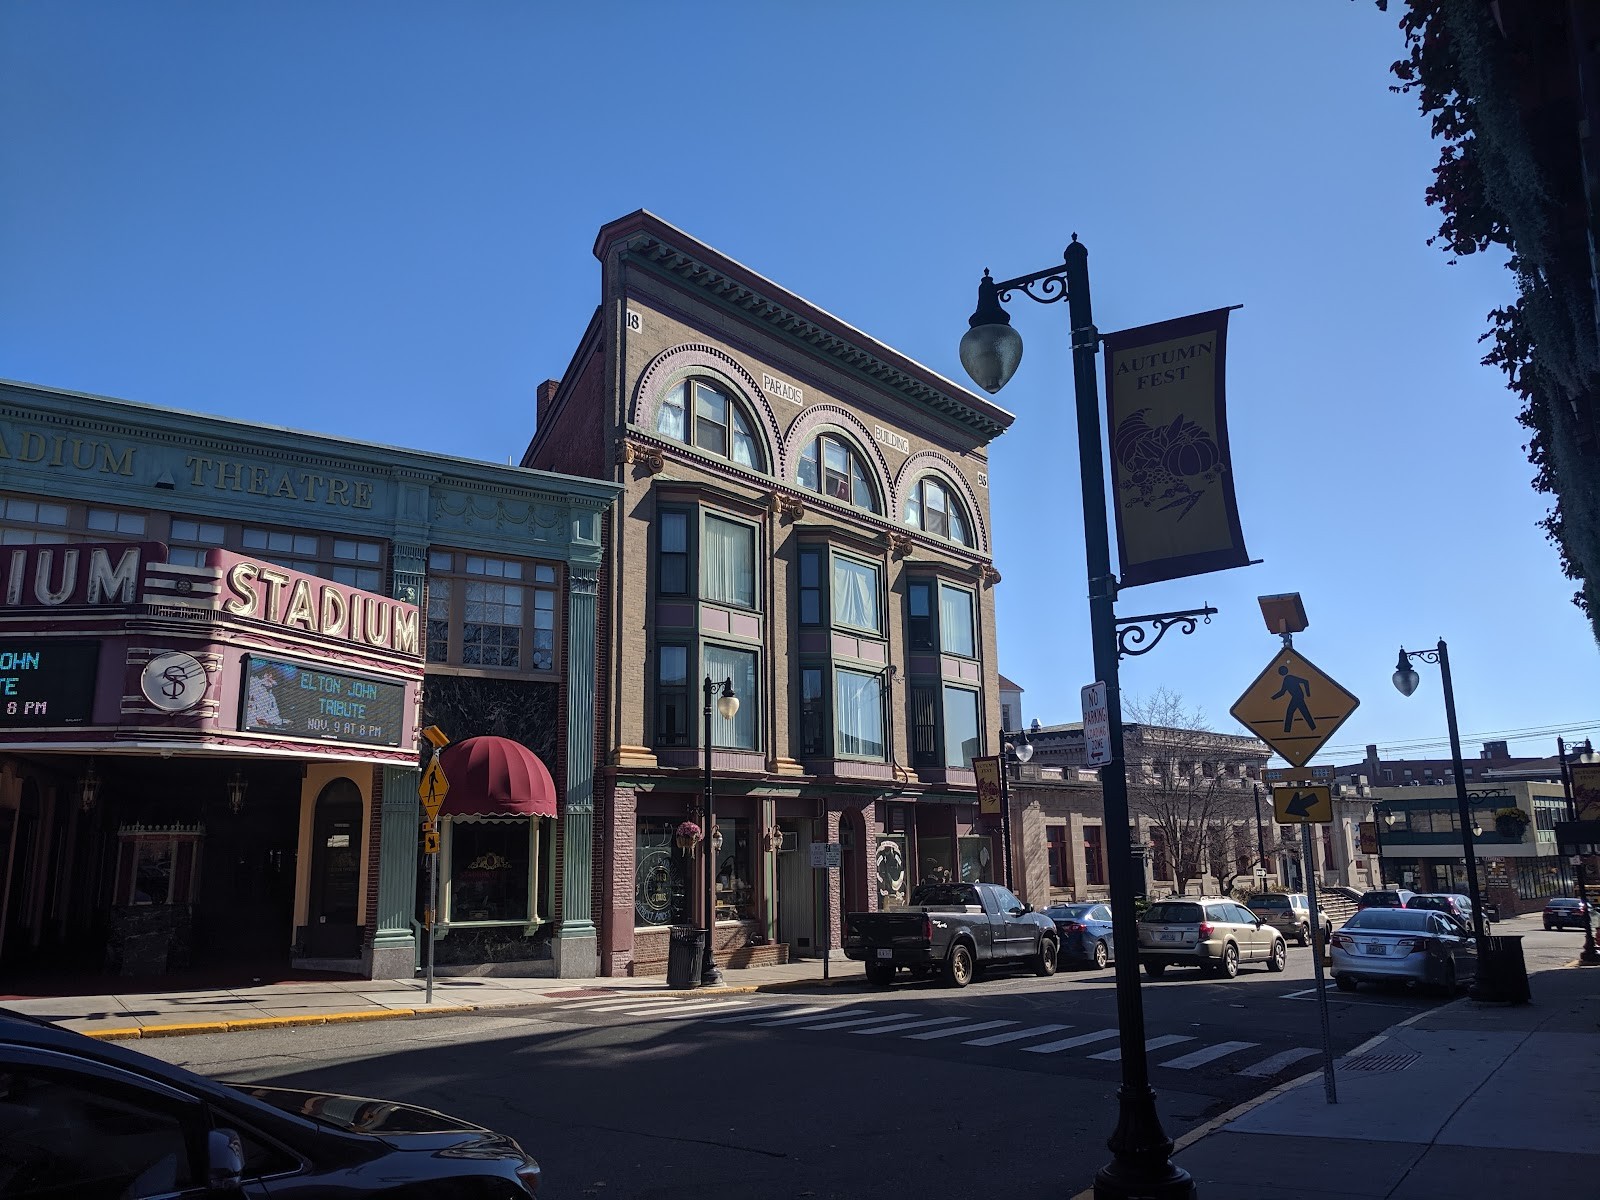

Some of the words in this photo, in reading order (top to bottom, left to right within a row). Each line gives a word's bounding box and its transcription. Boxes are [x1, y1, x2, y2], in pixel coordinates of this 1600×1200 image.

[626, 312, 640, 330] 18
[1116, 341, 1212, 376] AUTUMN
[763, 376, 803, 404] PARADIS
[1136, 365, 1190, 391] FEST
[874, 428, 909, 454] BUILDING
[186, 455, 374, 509] THEATRE
[221, 561, 419, 654] STADIUM
[300, 674, 341, 692] ELTON
[347, 681, 377, 699] JOHN
[1088, 690, 1099, 708] NO
[6, 701, 19, 716] 8
[24, 701, 48, 716] PM
[318, 699, 366, 718] TRIBUTE
[307, 717, 331, 732] NOV.
[335, 721, 341, 733] 9
[343, 722, 357, 735] AT
[360, 724, 366, 736] 8
[368, 725, 382, 738] PM
